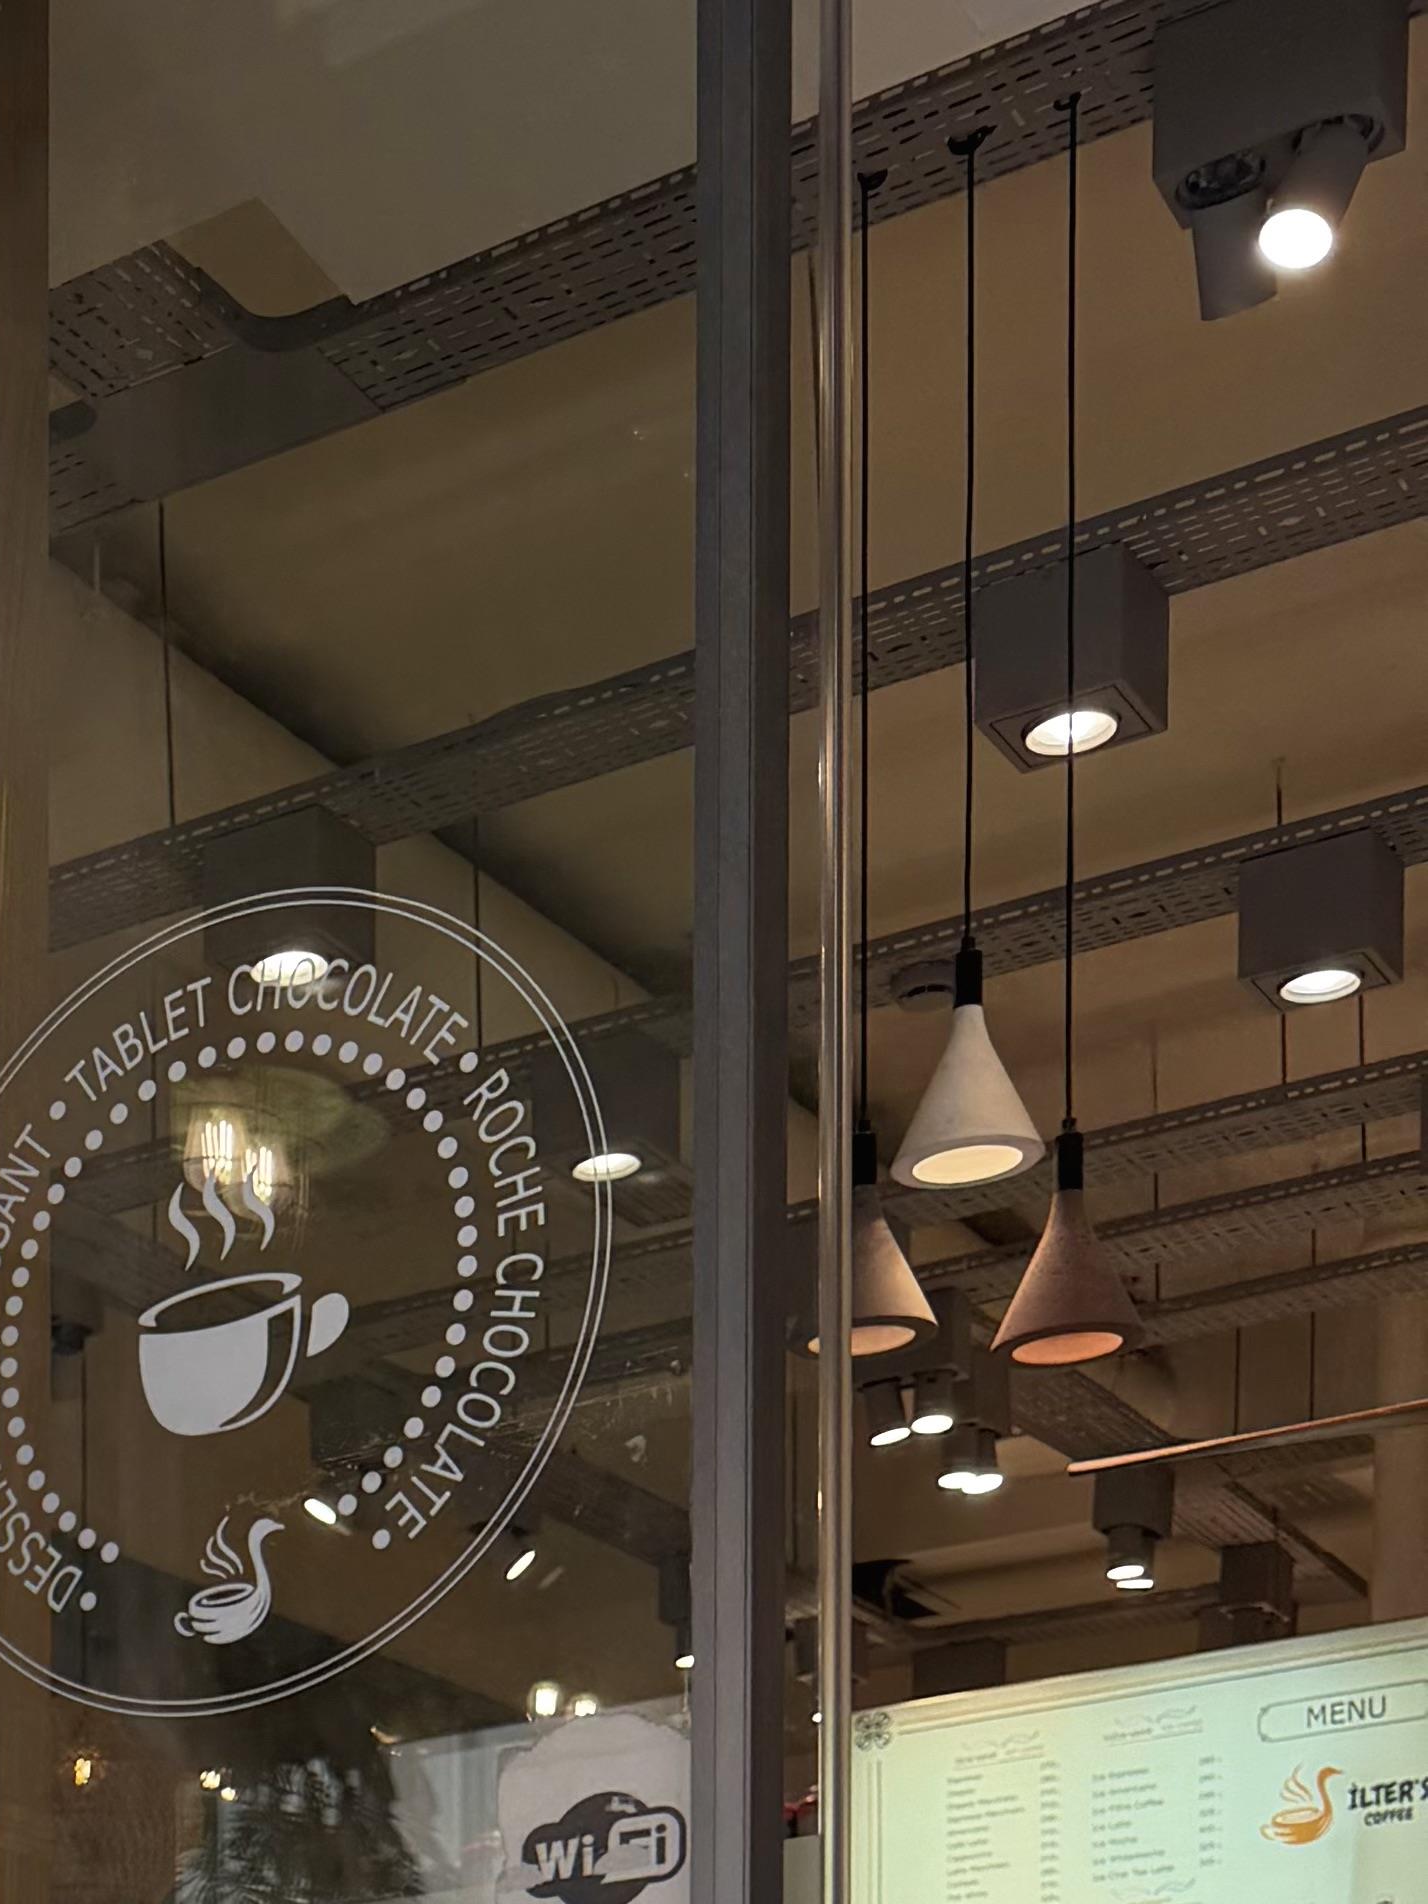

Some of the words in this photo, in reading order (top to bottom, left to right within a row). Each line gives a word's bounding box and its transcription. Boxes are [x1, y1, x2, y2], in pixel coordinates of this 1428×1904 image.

[63, 976, 212, 1101] TABLET
[227, 957, 470, 1066] CHOCOLATE
[463, 1068, 546, 1238] ROCHE
[385, 1252, 545, 1540] CHOCOLATE
[1306, 1695, 1387, 1729] MENU
[1364, 1806, 1414, 1827] COFFEE
